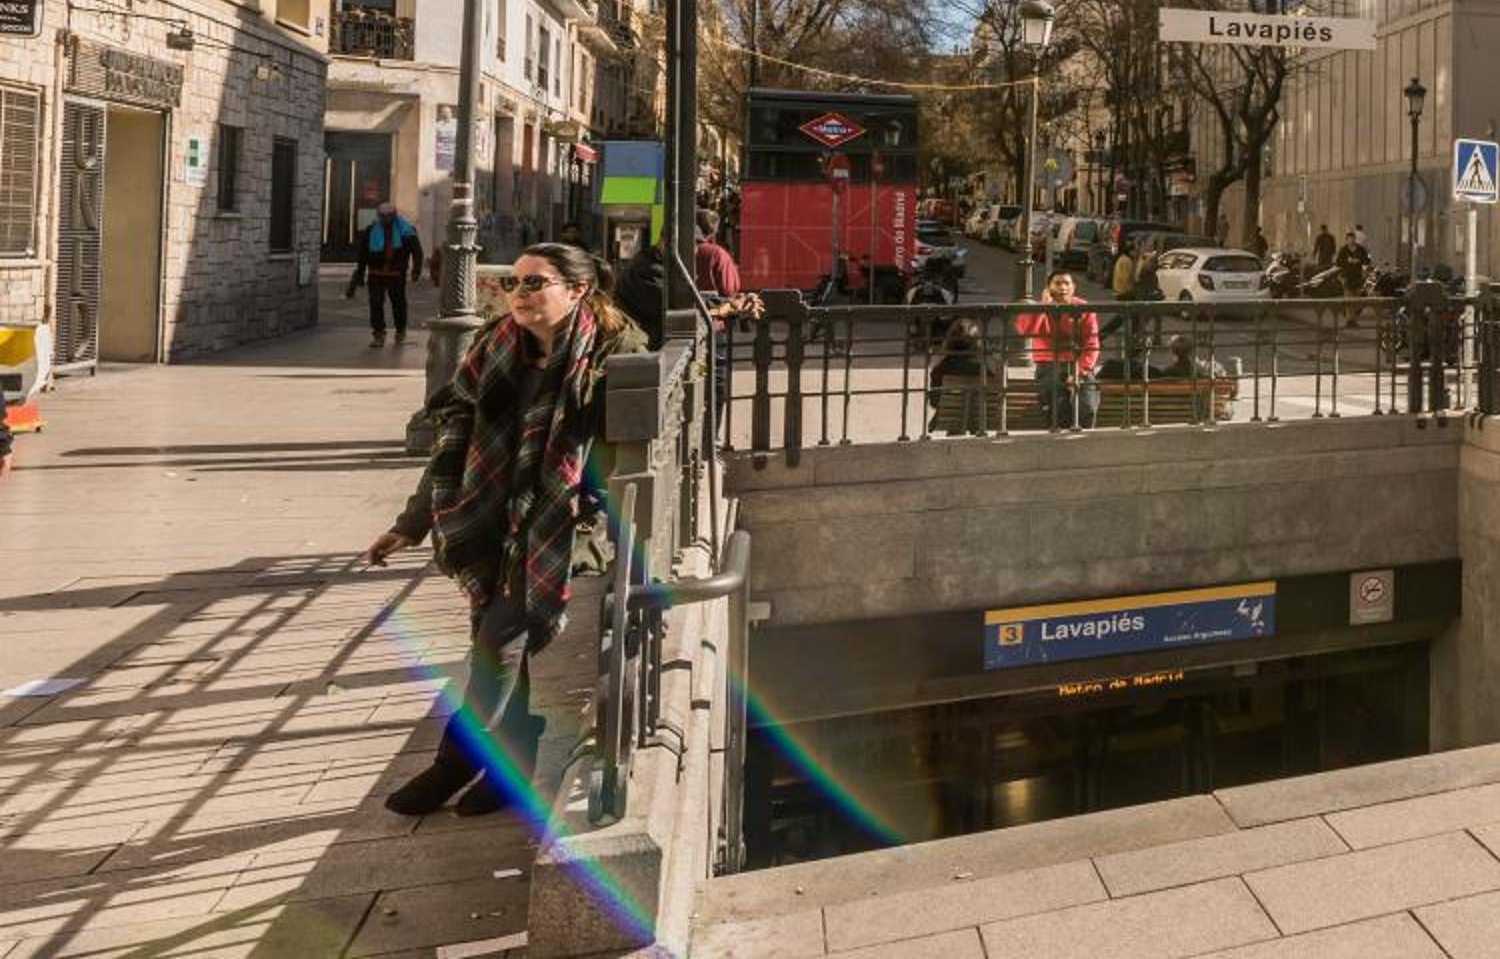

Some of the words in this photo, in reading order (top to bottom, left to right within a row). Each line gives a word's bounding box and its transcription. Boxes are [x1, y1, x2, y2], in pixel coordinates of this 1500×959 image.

[1209, 16, 1333, 42] Lavapiés
[1005, 627, 1018, 642] 3
[1041, 615, 1145, 641] Lavapiés
